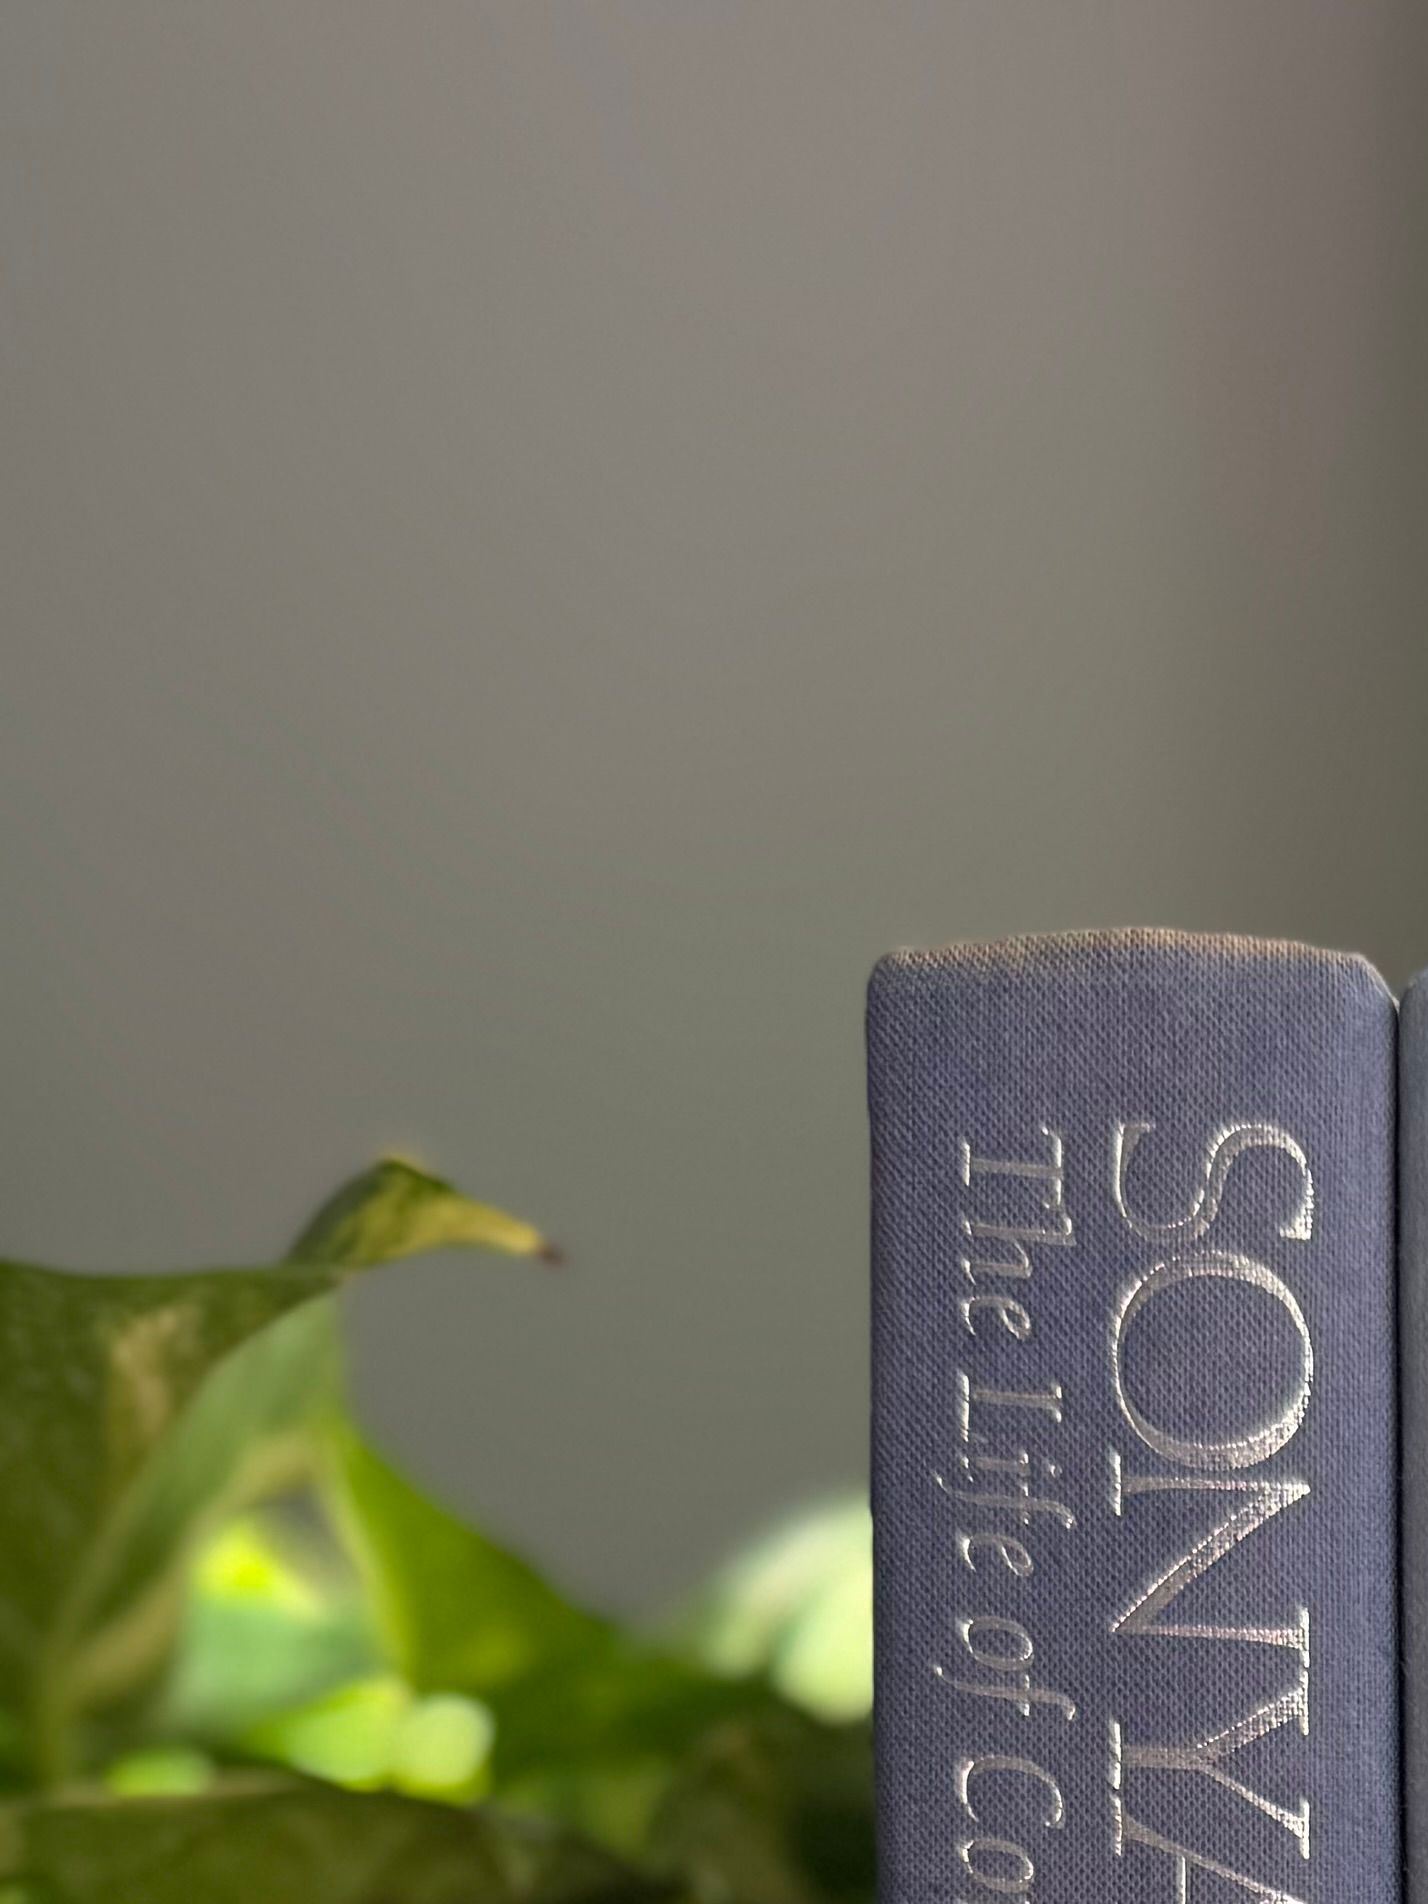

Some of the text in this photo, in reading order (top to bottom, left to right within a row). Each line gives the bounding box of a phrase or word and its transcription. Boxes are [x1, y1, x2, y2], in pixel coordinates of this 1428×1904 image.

[959, 1125, 1075, 1339] The
[934, 1370, 1076, 1577] Life
[931, 1617, 1075, 1721] of
